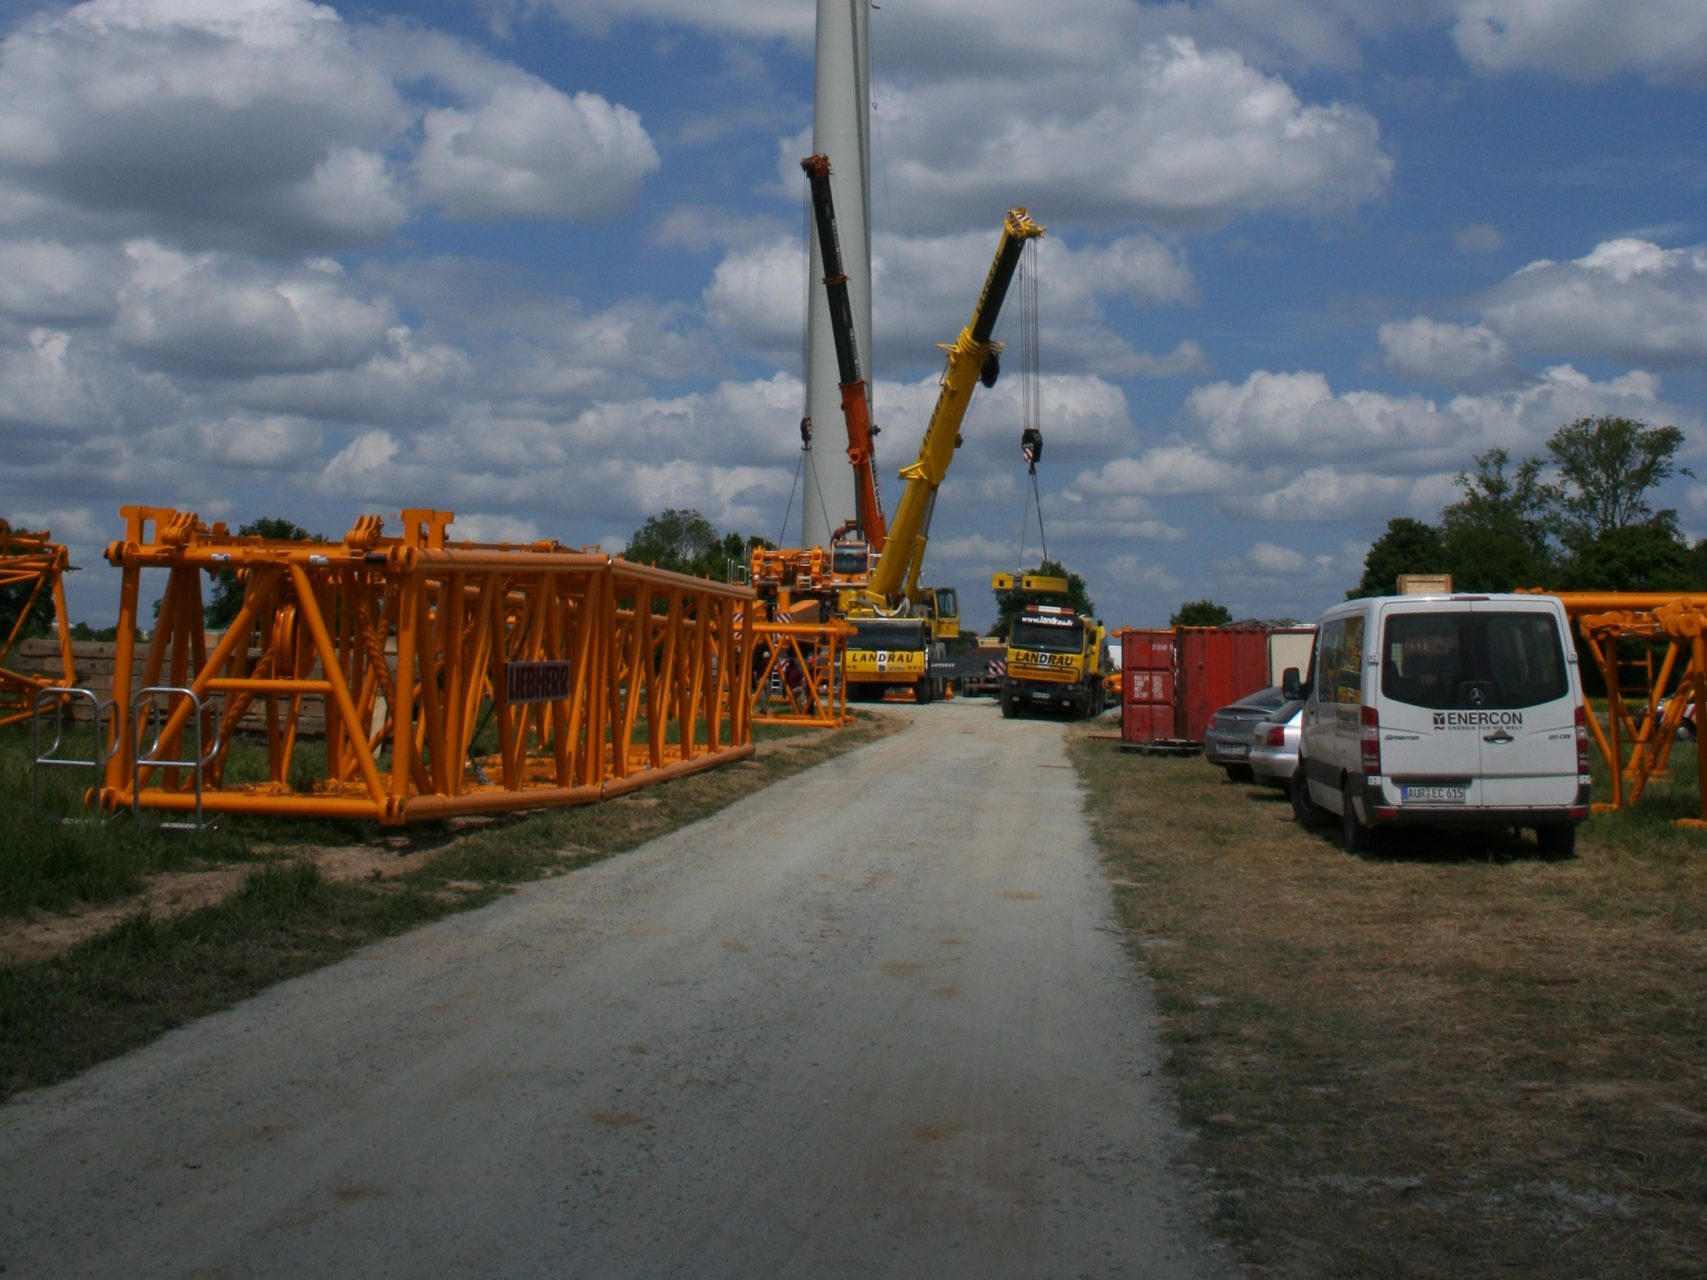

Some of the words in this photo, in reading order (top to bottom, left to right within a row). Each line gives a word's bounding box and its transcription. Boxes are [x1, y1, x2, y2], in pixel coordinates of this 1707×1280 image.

[1021, 616, 1074, 627] www.landrau.fr
[852, 652, 914, 663] LANDRAU
[1015, 652, 1074, 666] LANDRAU
[509, 665, 569, 699] LIEBHERR
[1447, 712, 1523, 725] ENERCON
[1408, 788, 1425, 799] AUR
[1432, 788, 1444, 799] EC
[1446, 787, 1463, 799] 615
